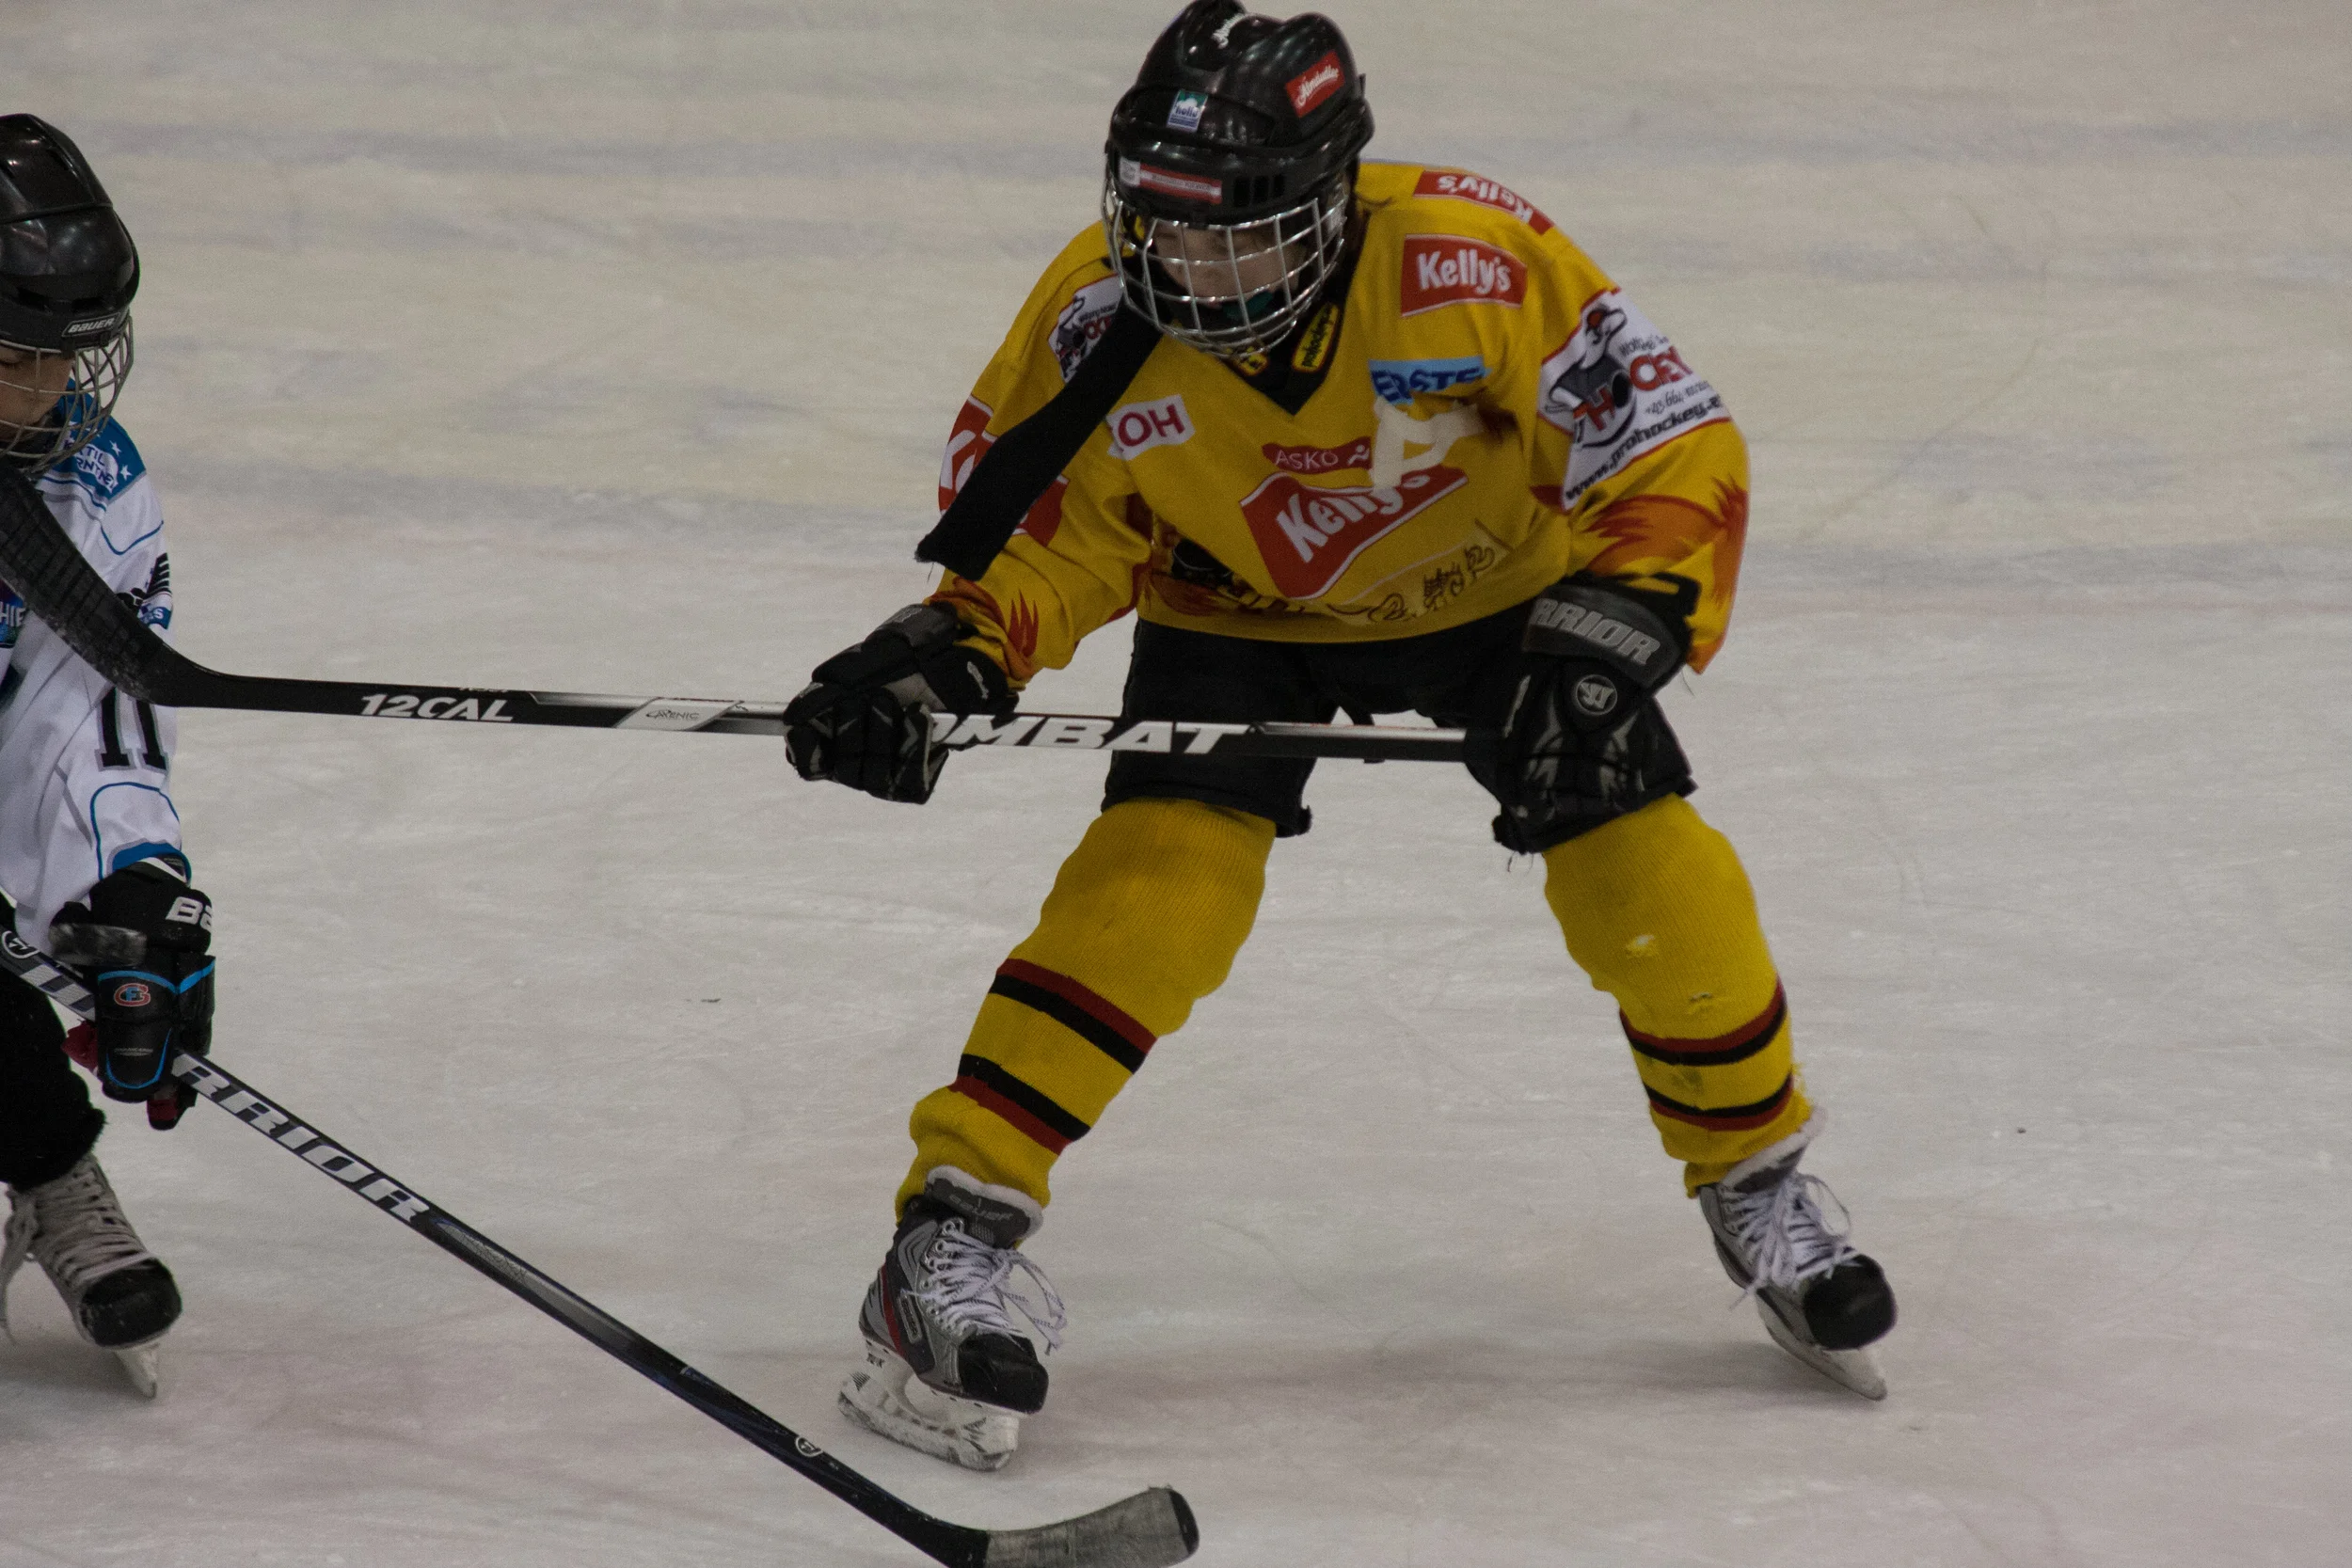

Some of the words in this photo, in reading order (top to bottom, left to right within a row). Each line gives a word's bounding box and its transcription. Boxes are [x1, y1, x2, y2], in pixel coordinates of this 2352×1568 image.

[1416, 248, 1512, 295] Kelly's
[1529, 597, 1661, 666] RRIOR
[359, 694, 515, 723] 12CAL
